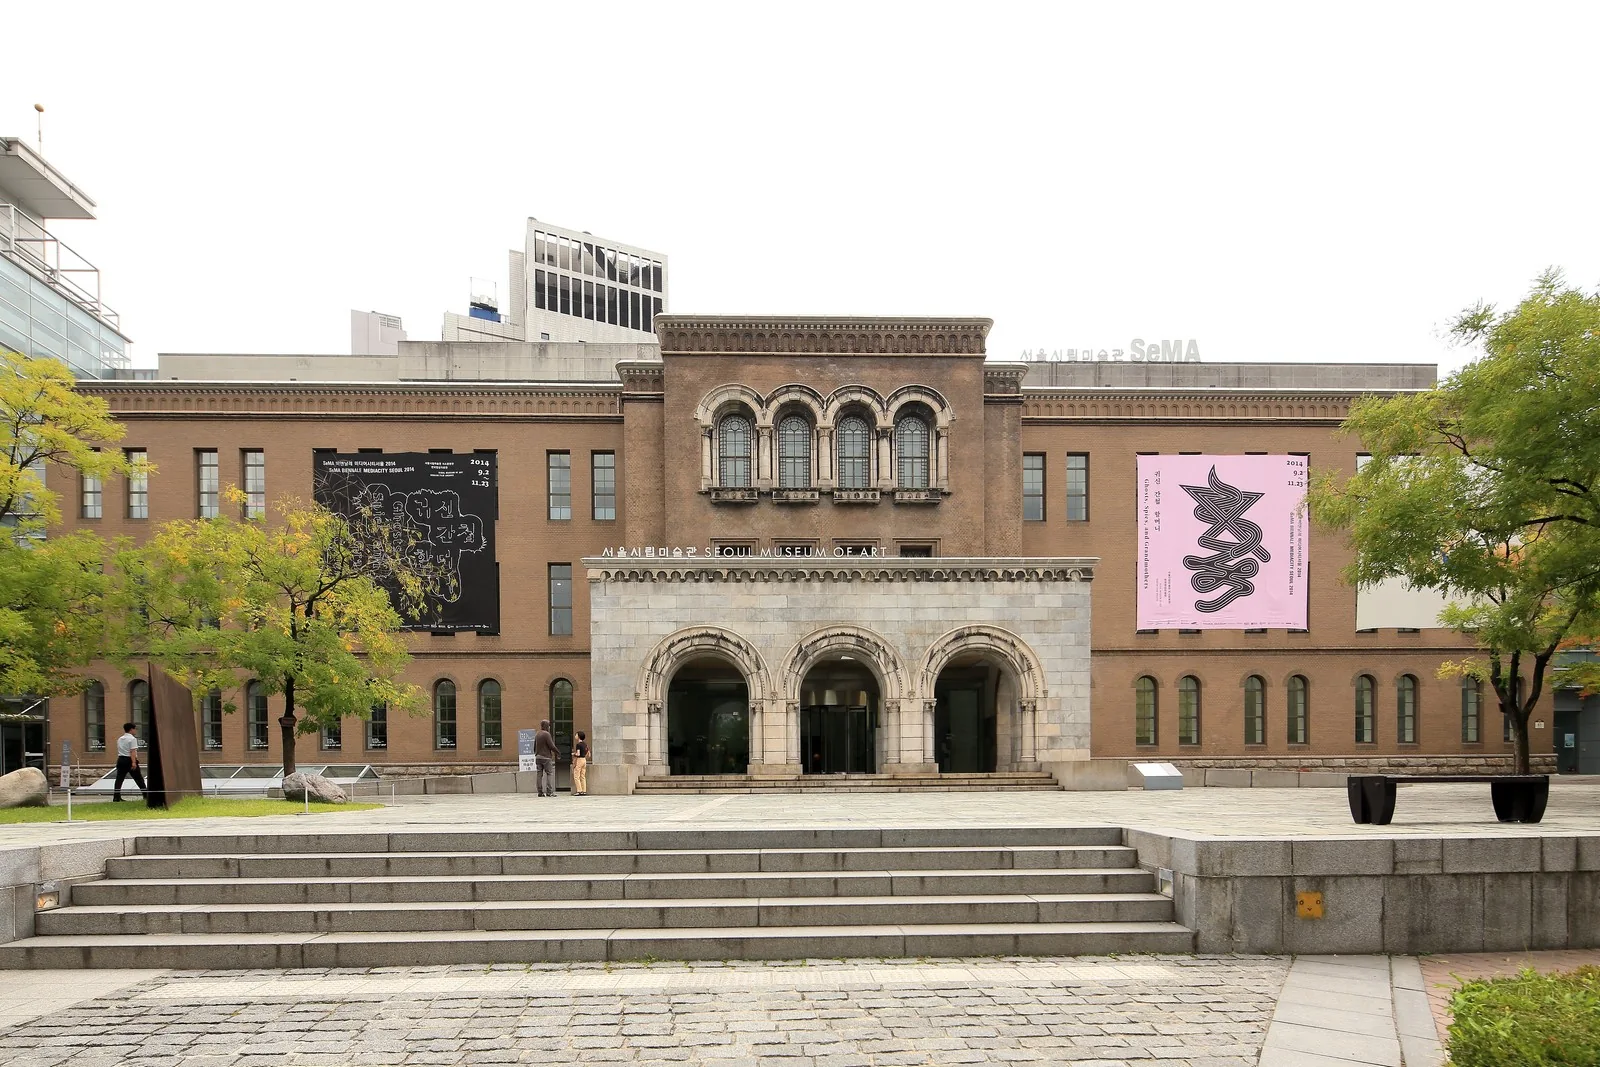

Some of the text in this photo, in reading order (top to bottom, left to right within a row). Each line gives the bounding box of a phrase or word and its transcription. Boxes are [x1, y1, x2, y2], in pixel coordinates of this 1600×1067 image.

[1020, 348, 1124, 362] 서울시립미술관
[1130, 338, 1201, 362] SeMA
[470, 459, 490, 467] 2014
[471, 480, 490, 488] 11.23
[601, 546, 887, 558] 서울시립미술관 SEOUL MUSEUM OF ART
